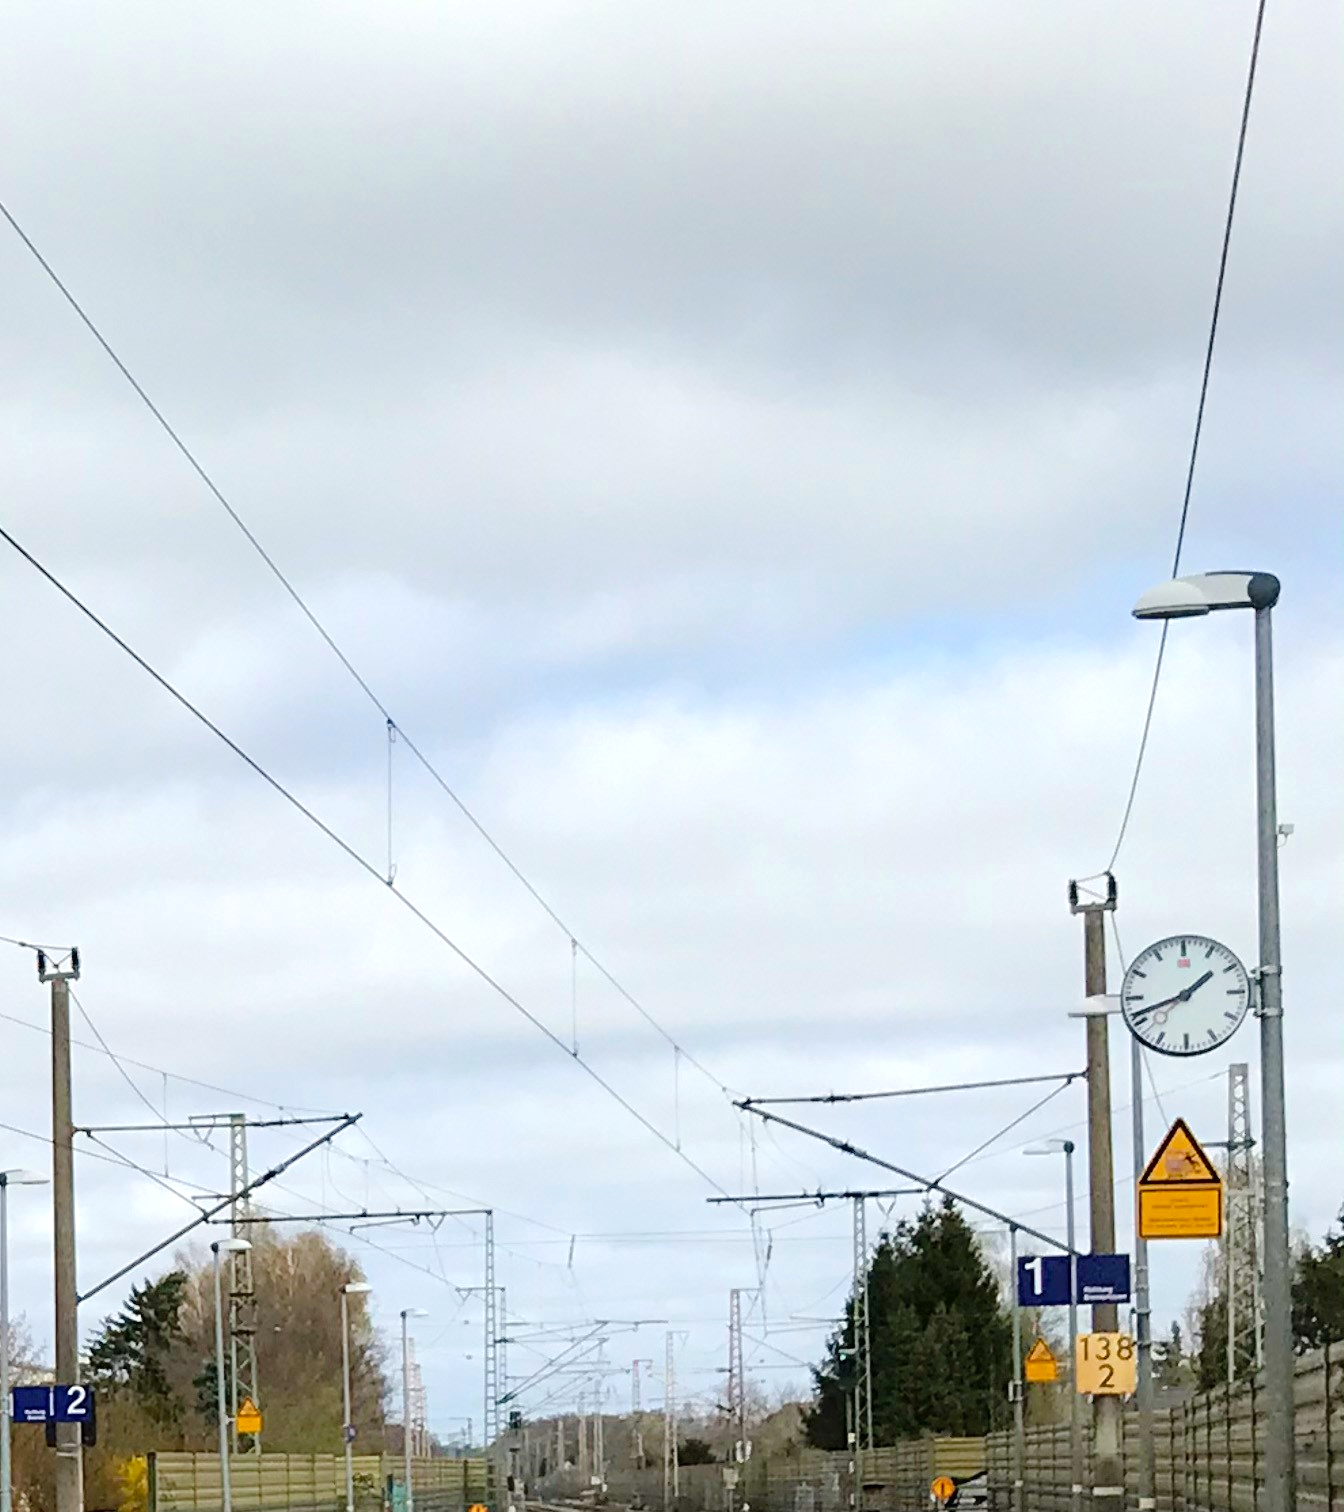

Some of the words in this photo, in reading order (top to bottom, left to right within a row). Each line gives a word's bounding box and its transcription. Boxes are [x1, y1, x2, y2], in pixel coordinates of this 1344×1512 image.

[1024, 1257, 1043, 1295] 1
[1079, 1336, 1134, 1362] 138
[1097, 1363, 1115, 1389] 2
[66, 1385, 87, 1415] 2
